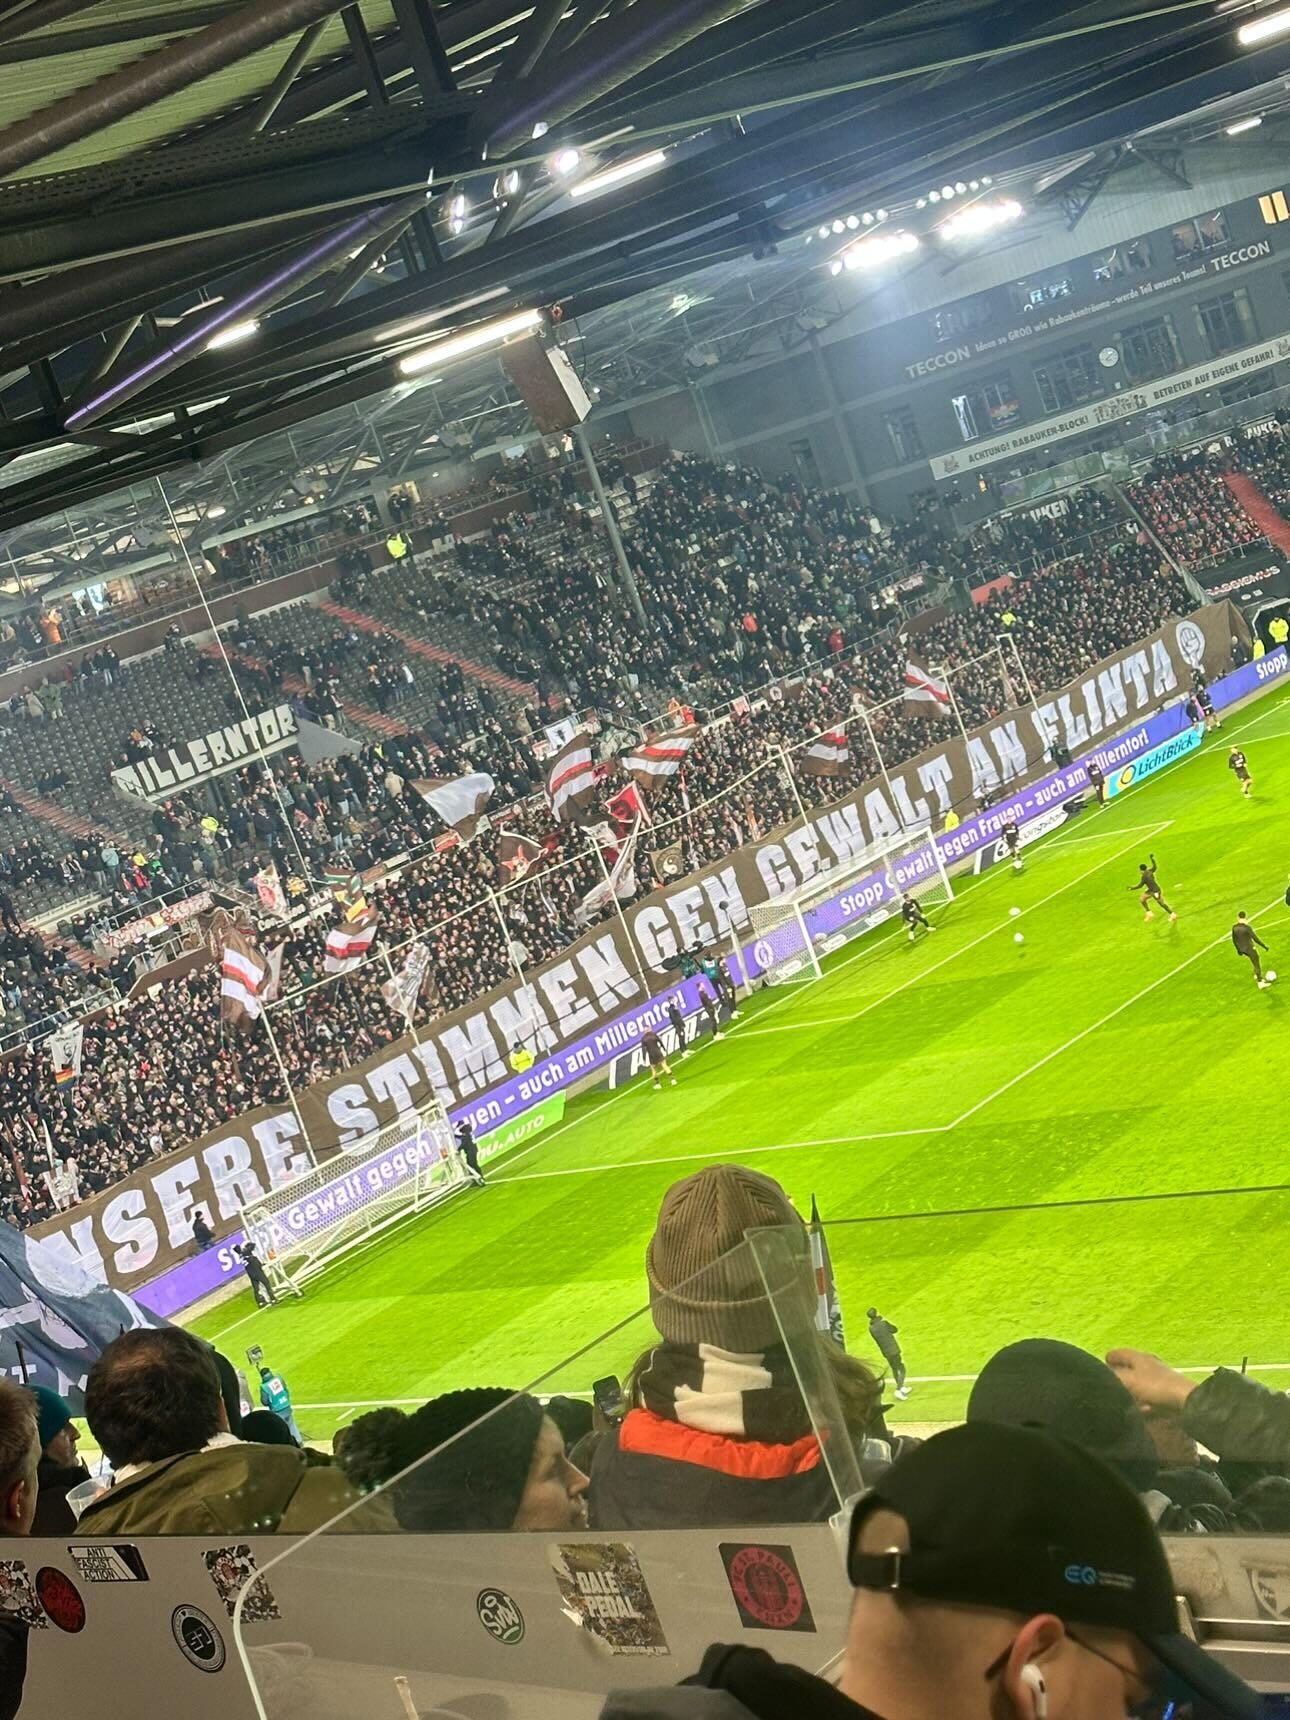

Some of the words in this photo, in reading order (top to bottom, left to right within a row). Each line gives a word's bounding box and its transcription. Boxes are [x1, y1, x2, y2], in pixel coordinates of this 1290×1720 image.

[905, 346, 971, 379] TECCON
[1211, 240, 1271, 272] TECCON
[1153, 380, 1193, 400] BETRETEN
[1194, 373, 1212, 386] AUF
[1212, 361, 1240, 379] EIGENE
[1240, 350, 1275, 369] GEFAHR!
[968, 442, 1011, 463] ACHTUNG!
[1012, 415, 1089, 449] RABAUKEN-BLOCK!
[1256, 652, 1289, 680] Stopp
[1137, 734, 1194, 776] LichtBlick
[840, 880, 884, 916] Stopp
[978, 801, 1025, 836] Frauen
[1034, 778, 1067, 806] auch
[1067, 766, 1088, 790] am
[328, 933, 641, 1157] STIMMEN
[755, 754, 953, 901] GEWALT
[965, 720, 1028, 799] AN
[1030, 639, 1178, 764] FLINTA
[287, 1173, 364, 1229] Gewalt
[366, 1137, 432, 1192] gegen
[518, 1061, 564, 1103] auch
[566, 1045, 596, 1073] am
[84, 1569, 117, 1580] ACTION
[87, 1547, 107, 1558] ANTI
[1064, 1565, 1096, 1585] EQ
[575, 1571, 620, 1594] DALE
